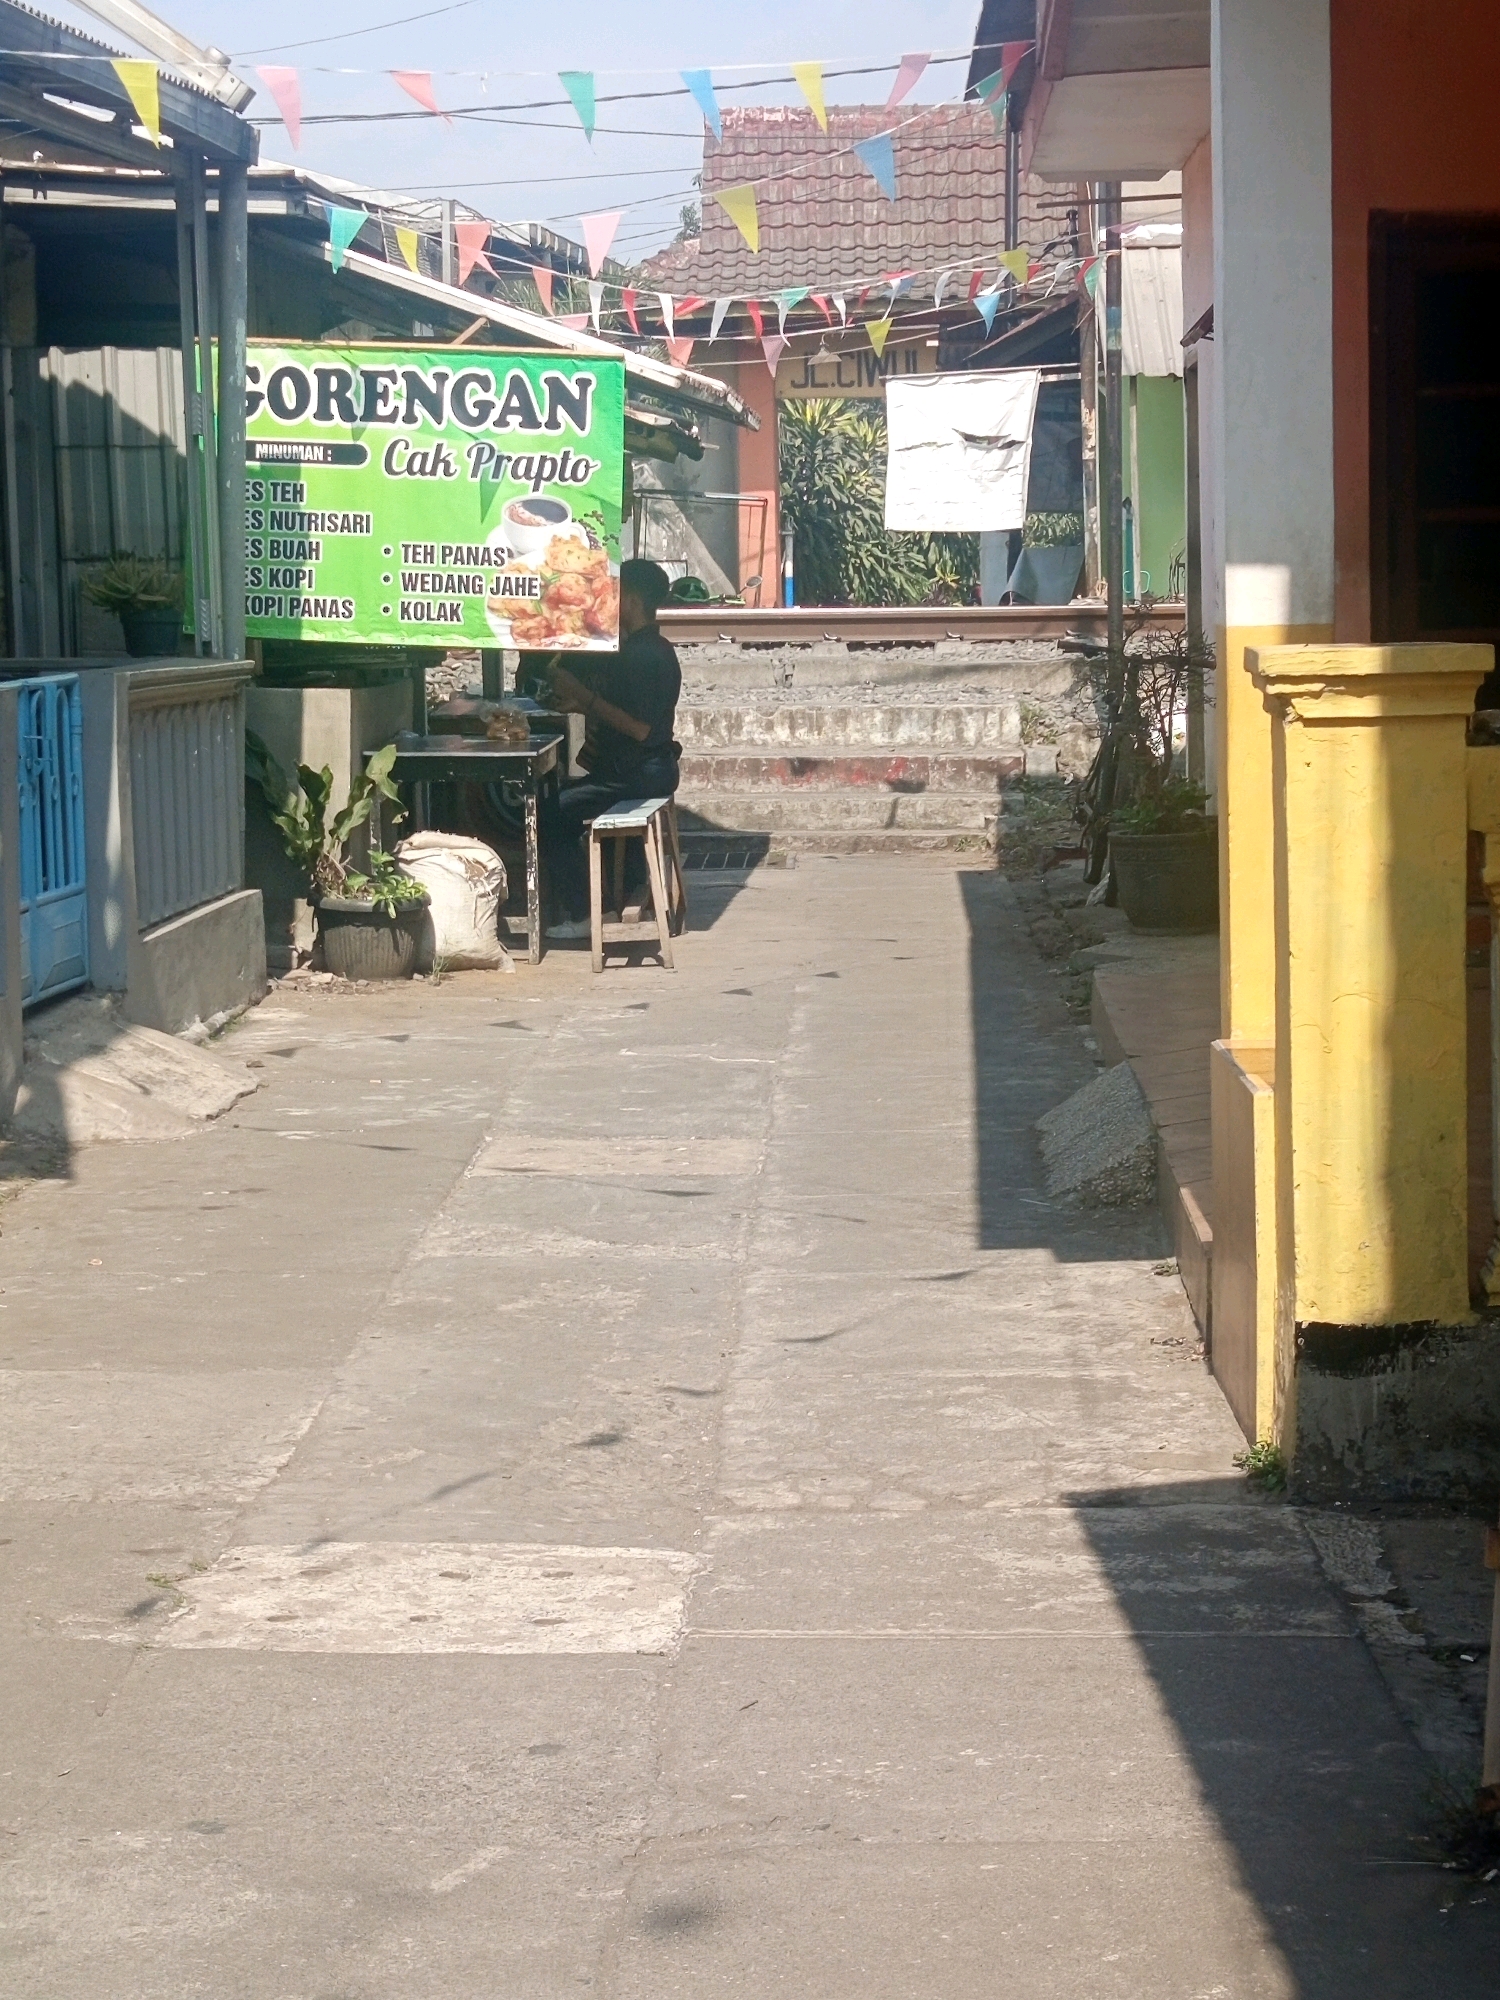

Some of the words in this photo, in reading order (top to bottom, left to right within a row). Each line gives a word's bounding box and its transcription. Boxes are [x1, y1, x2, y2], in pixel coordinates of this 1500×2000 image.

[256, 443, 324, 461] MINUMAN
[384, 438, 458, 477] Cak
[467, 441, 599, 492] Prapto
[270, 482, 305, 502] TEH
[269, 511, 372, 534] NUTRISARI
[269, 539, 321, 561] BUAH
[402, 544, 435, 565] TEH
[441, 545, 506, 567] PANAS
[269, 567, 314, 589] KOPI
[401, 572, 484, 595] WEDANG
[489, 575, 539, 597] JAHE
[289, 597, 354, 619] PANAS
[400, 600, 462, 622] KOLAK
